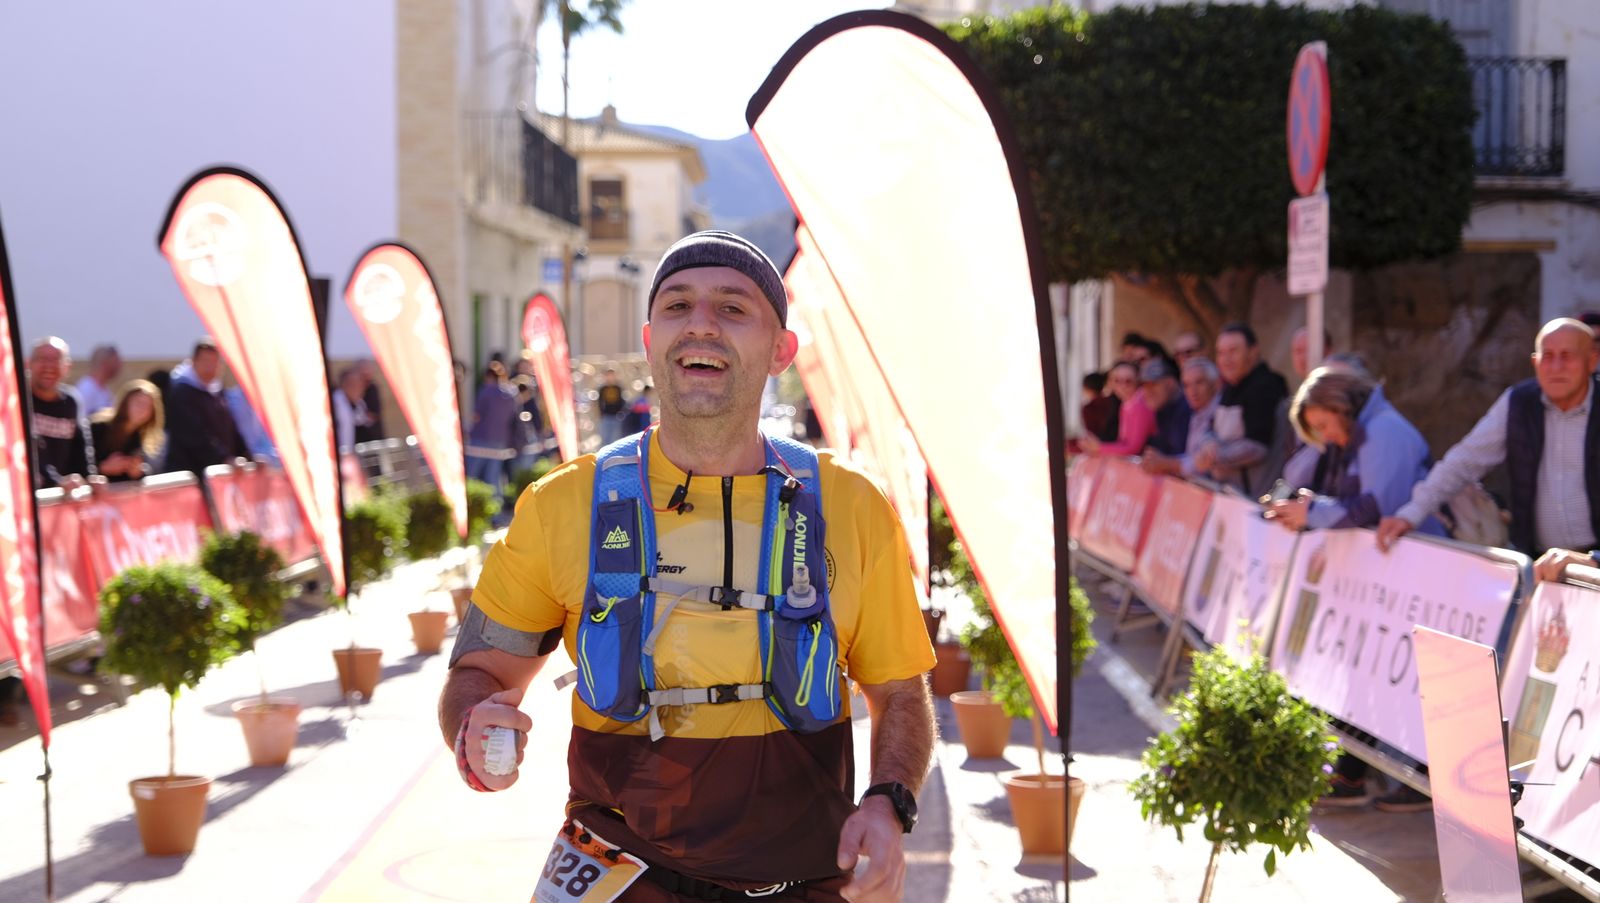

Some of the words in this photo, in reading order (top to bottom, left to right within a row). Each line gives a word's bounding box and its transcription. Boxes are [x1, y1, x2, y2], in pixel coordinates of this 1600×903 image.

[656, 565, 686, 574] ERGY
[1316, 606, 1419, 694] CANTO
[542, 843, 600, 897] 328
